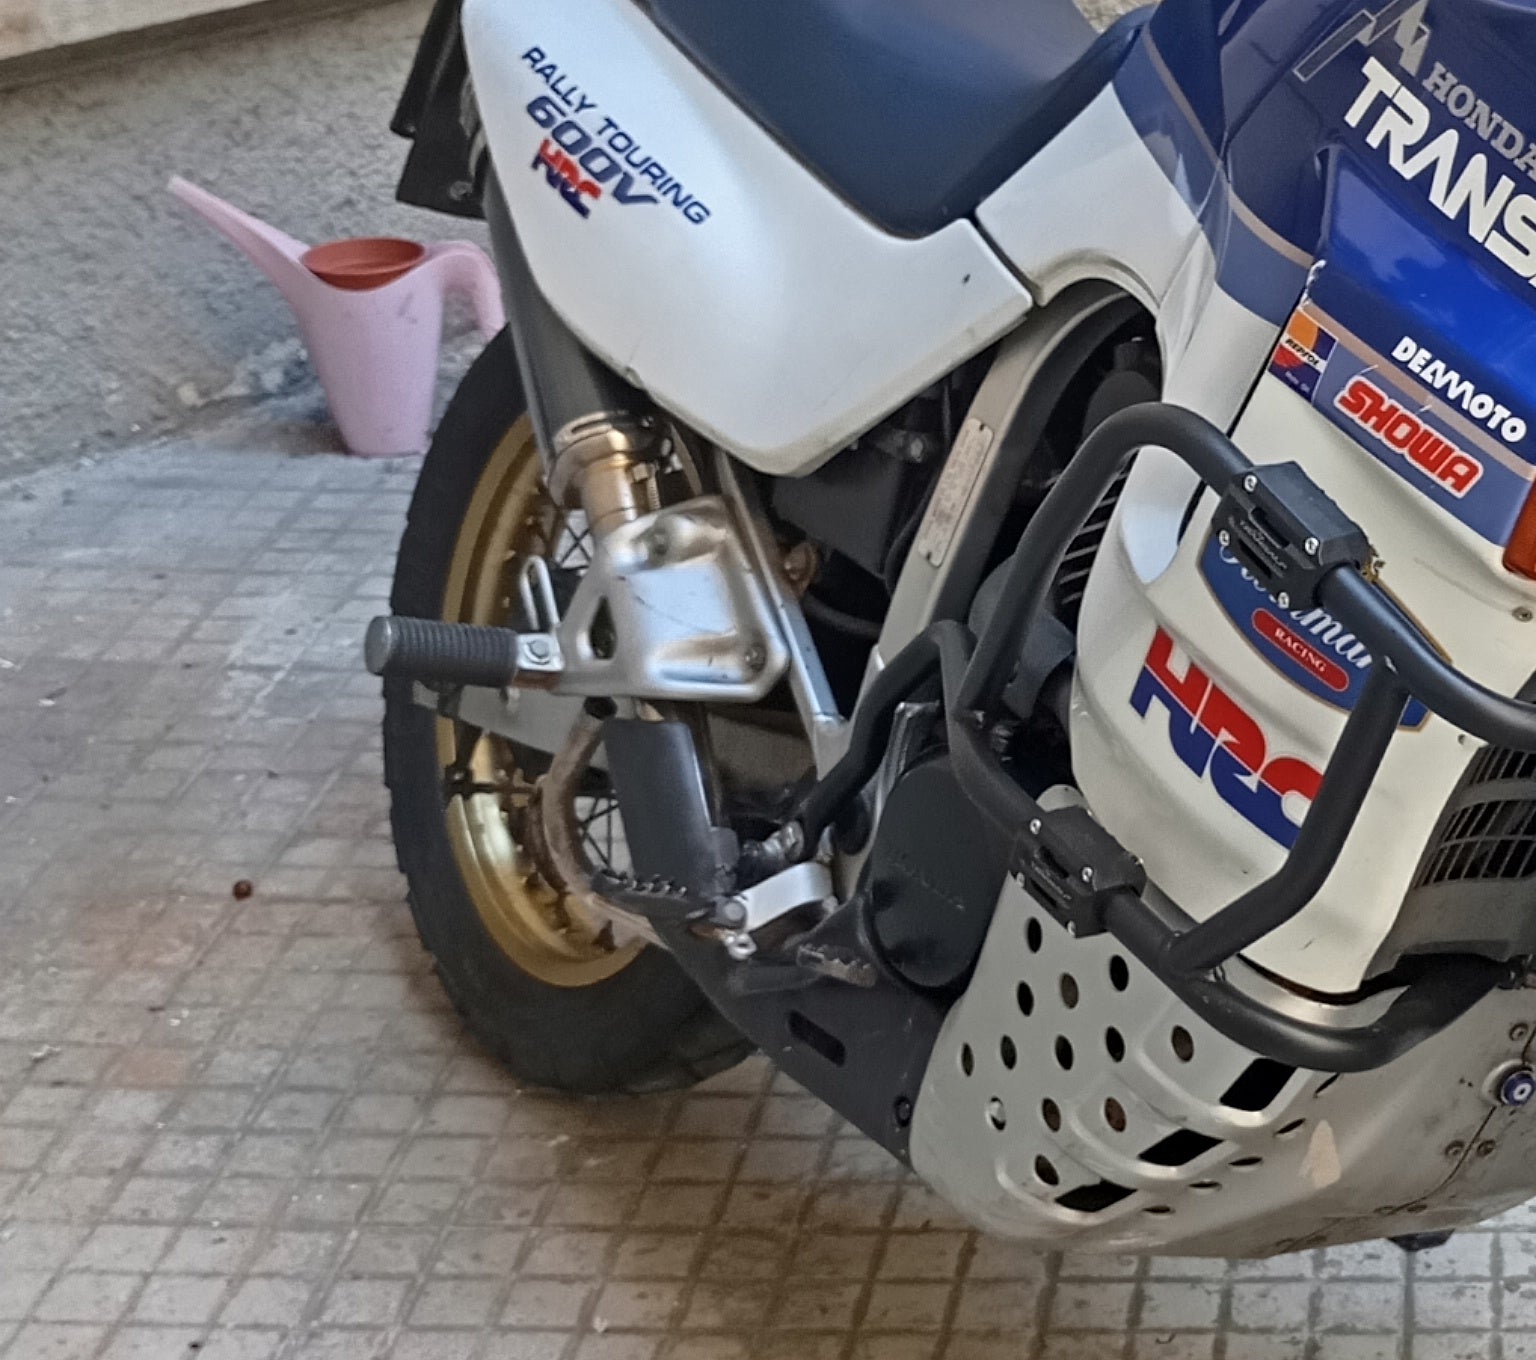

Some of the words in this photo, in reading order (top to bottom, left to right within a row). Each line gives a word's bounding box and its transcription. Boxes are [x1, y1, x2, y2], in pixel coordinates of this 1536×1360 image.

[521, 45, 597, 113] RALLY
[596, 115, 712, 225] TOURING
[526, 95, 660, 205] 600V
[1336, 376, 1483, 497] SHOWA
[1273, 626, 1327, 674] RACING
